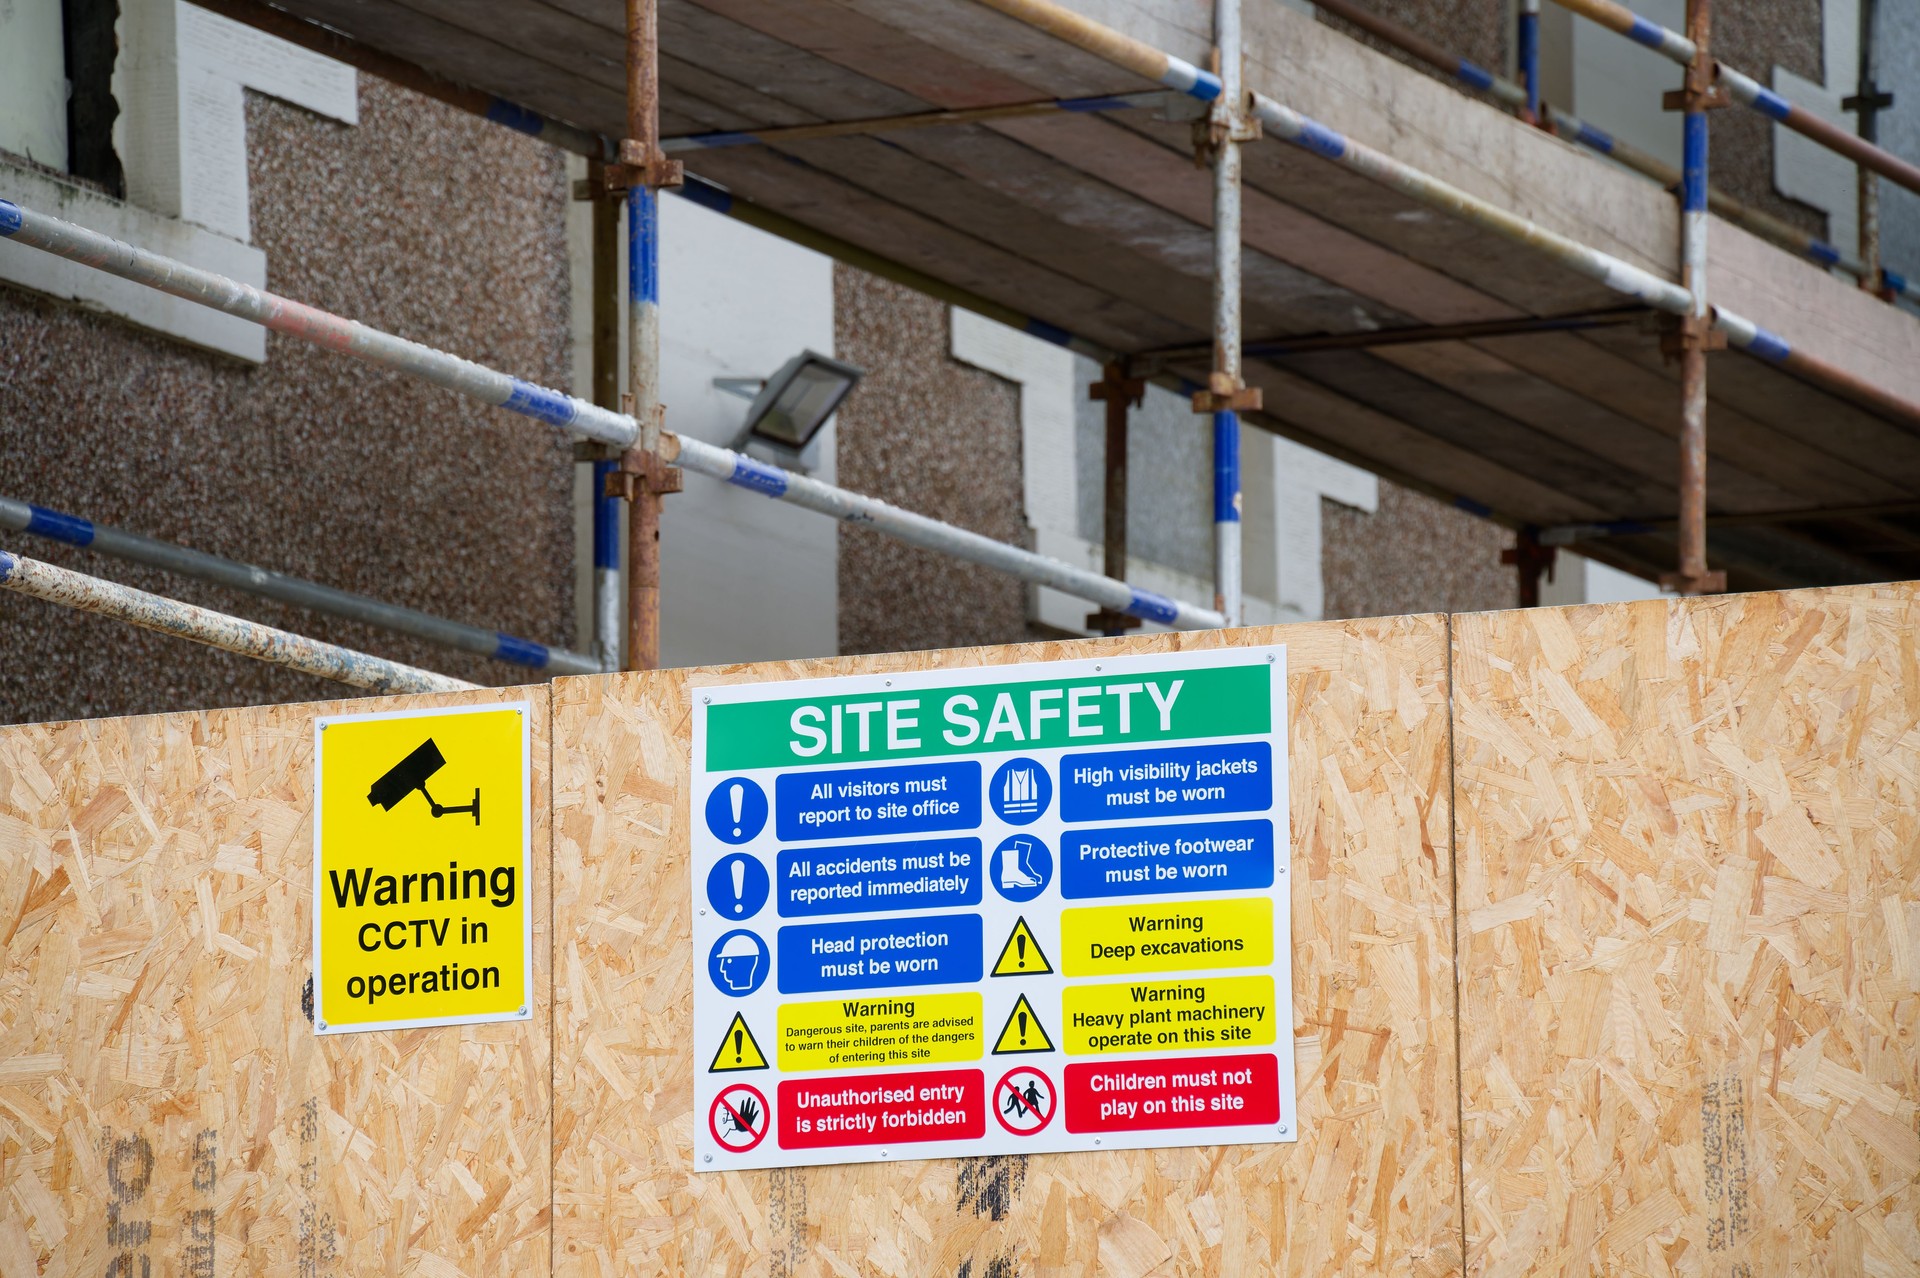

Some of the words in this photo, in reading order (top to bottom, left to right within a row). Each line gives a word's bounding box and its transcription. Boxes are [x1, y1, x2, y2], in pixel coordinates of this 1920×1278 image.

[789, 699, 922, 758] SITE
[942, 679, 1185, 747] SAFETY
[1075, 767, 1113, 786] High
[1119, 763, 1190, 781] visibility
[1196, 759, 1257, 780] jackets
[811, 784, 832, 799] All
[838, 781, 899, 797] visitors
[906, 777, 946, 793] must
[1107, 789, 1149, 805] must
[1156, 788, 1177, 802] be
[1182, 787, 1224, 800] worn
[800, 807, 850, 826] report
[855, 806, 872, 820] to
[878, 803, 907, 818] site
[913, 800, 959, 816] office
[1080, 841, 1170, 860] Protective
[1175, 838, 1254, 854] footwear
[789, 861, 810, 877] All
[816, 857, 896, 876] accidents
[903, 853, 944, 869] must
[950, 852, 970, 866] be
[1106, 866, 1149, 882] must
[1156, 864, 1177, 879] be
[1183, 864, 1227, 878] worn
[329, 862, 514, 908] Warning
[791, 882, 861, 904] reported
[868, 875, 968, 896] immediately
[359, 918, 450, 951] CCTV
[462, 917, 487, 944] in
[1129, 915, 1202, 932] Warning
[812, 936, 854, 954] Head
[861, 932, 948, 955] protection
[1091, 944, 1135, 960] Deep
[1141, 937, 1243, 956] excavations
[822, 961, 863, 977] must
[870, 959, 890, 974] be
[895, 959, 938, 972] worn
[347, 963, 499, 1004] operation
[1131, 985, 1204, 1003] Warning
[843, 1000, 914, 1017] Warning
[1074, 1013, 1123, 1029] Heavy
[1130, 1009, 1171, 1028] plant
[1177, 1005, 1265, 1021] machinery
[787, 1027, 842, 1039] Dangerous
[846, 1024, 866, 1033] site,
[871, 1021, 909, 1033] parents
[933, 1017, 973, 1027] advised
[1089, 1032, 1152, 1050] operate
[1158, 1032, 1177, 1043] on
[1184, 1027, 1214, 1042] this
[1221, 1026, 1251, 1040] site
[786, 1043, 795, 1051] to
[799, 1042, 823, 1050] warn
[827, 1039, 850, 1048] their
[853, 1037, 895, 1047] children
[899, 1035, 908, 1044] of
[912, 1034, 928, 1043] the
[932, 1033, 974, 1043] dangers
[830, 1054, 839, 1063] of
[843, 1053, 885, 1062] entering
[889, 1050, 907, 1059] this
[912, 1049, 930, 1058] site
[1091, 1074, 1166, 1091] Children
[1173, 1070, 1217, 1087] must
[1223, 1069, 1252, 1085] not
[798, 1086, 914, 1108] Unauthorised
[920, 1085, 964, 1103] entry
[1101, 1099, 1137, 1120] play
[1144, 1100, 1165, 1113] on
[1171, 1095, 1205, 1112] this
[1211, 1094, 1243, 1110] site
[797, 1117, 811, 1132] is
[817, 1113, 876, 1132] strictly
[882, 1108, 965, 1127] forbidden
